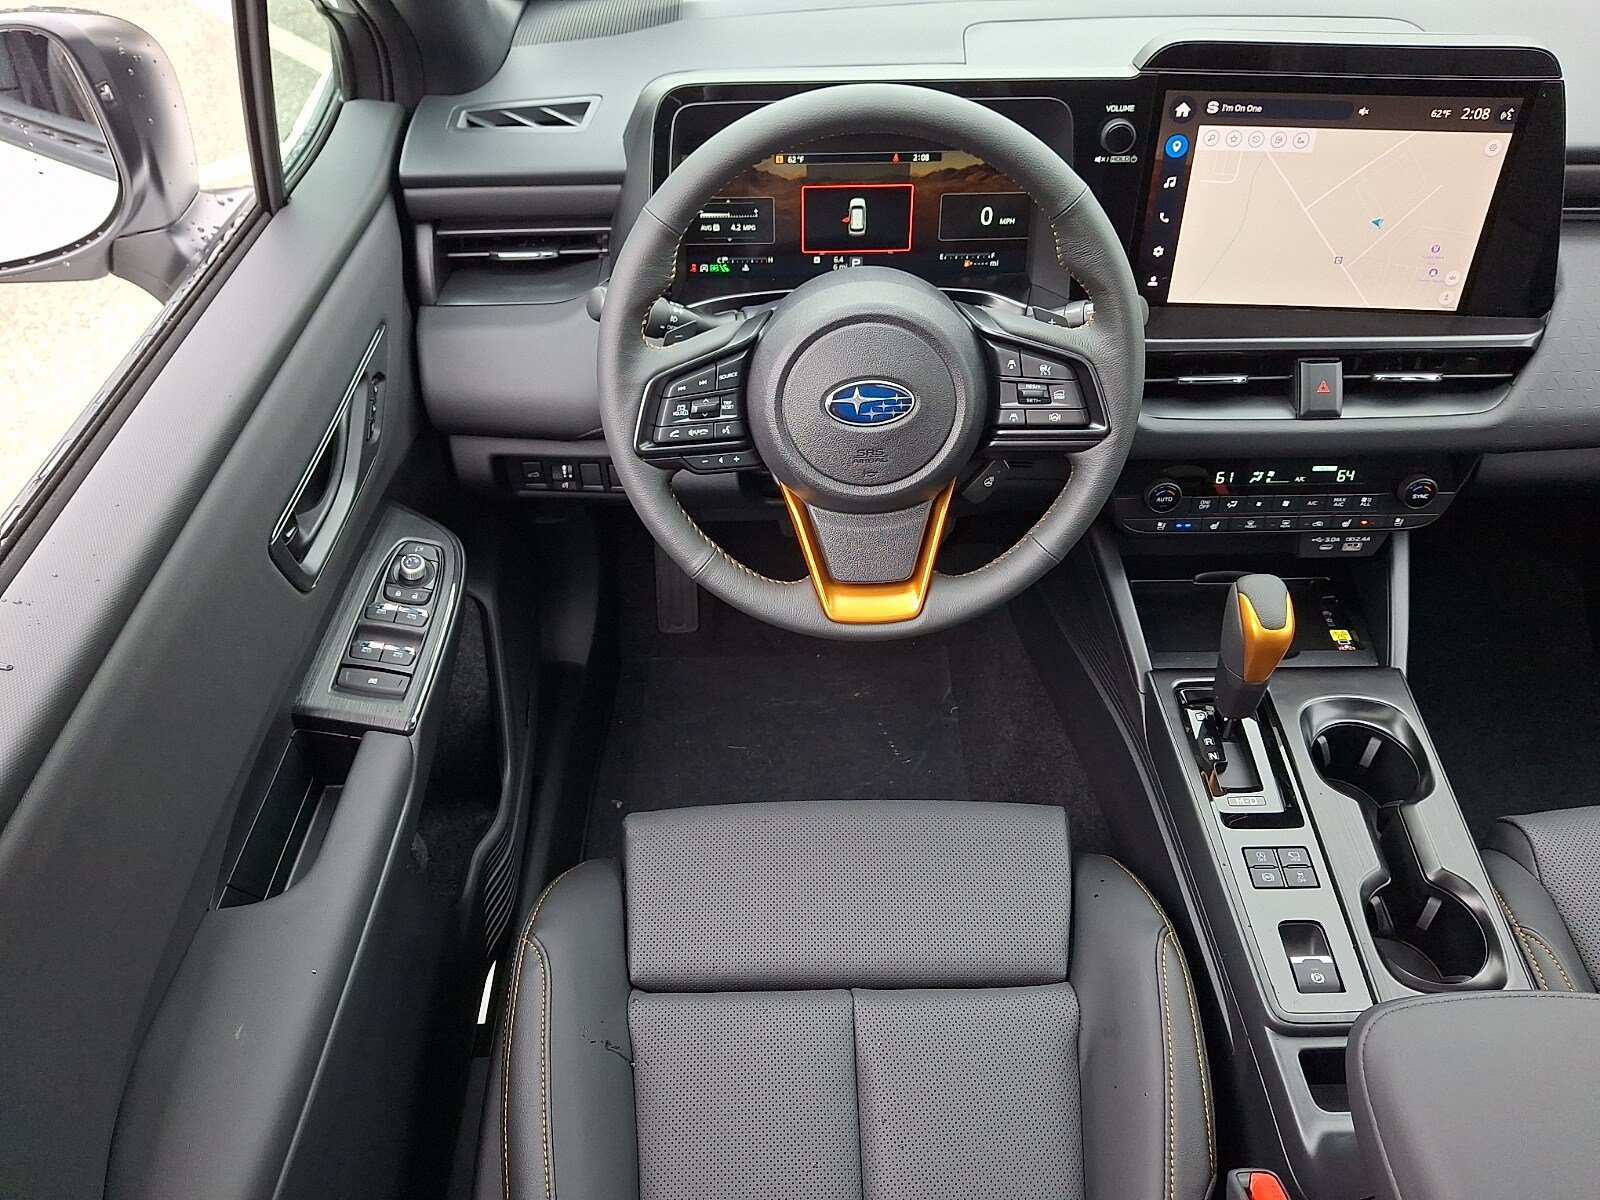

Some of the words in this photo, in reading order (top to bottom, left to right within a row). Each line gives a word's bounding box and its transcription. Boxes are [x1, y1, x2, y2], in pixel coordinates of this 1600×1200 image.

[1105, 104, 1136, 112] VOLUME
[1221, 103, 1233, 112] I'm
[1234, 104, 1246, 112] On
[1246, 104, 1262, 113] One
[1460, 107, 1491, 120] 2:08
[912, 153, 930, 162] 2:08
[980, 206, 993, 226] 0
[999, 217, 1016, 225] MPH
[730, 223, 742, 231] 4.2
[719, 371, 738, 380] SOURCE
[1215, 471, 1235, 484] 61
[1336, 469, 1356, 482] 64
[1203, 737, 1215, 746] R
[1207, 752, 1219, 760] N
